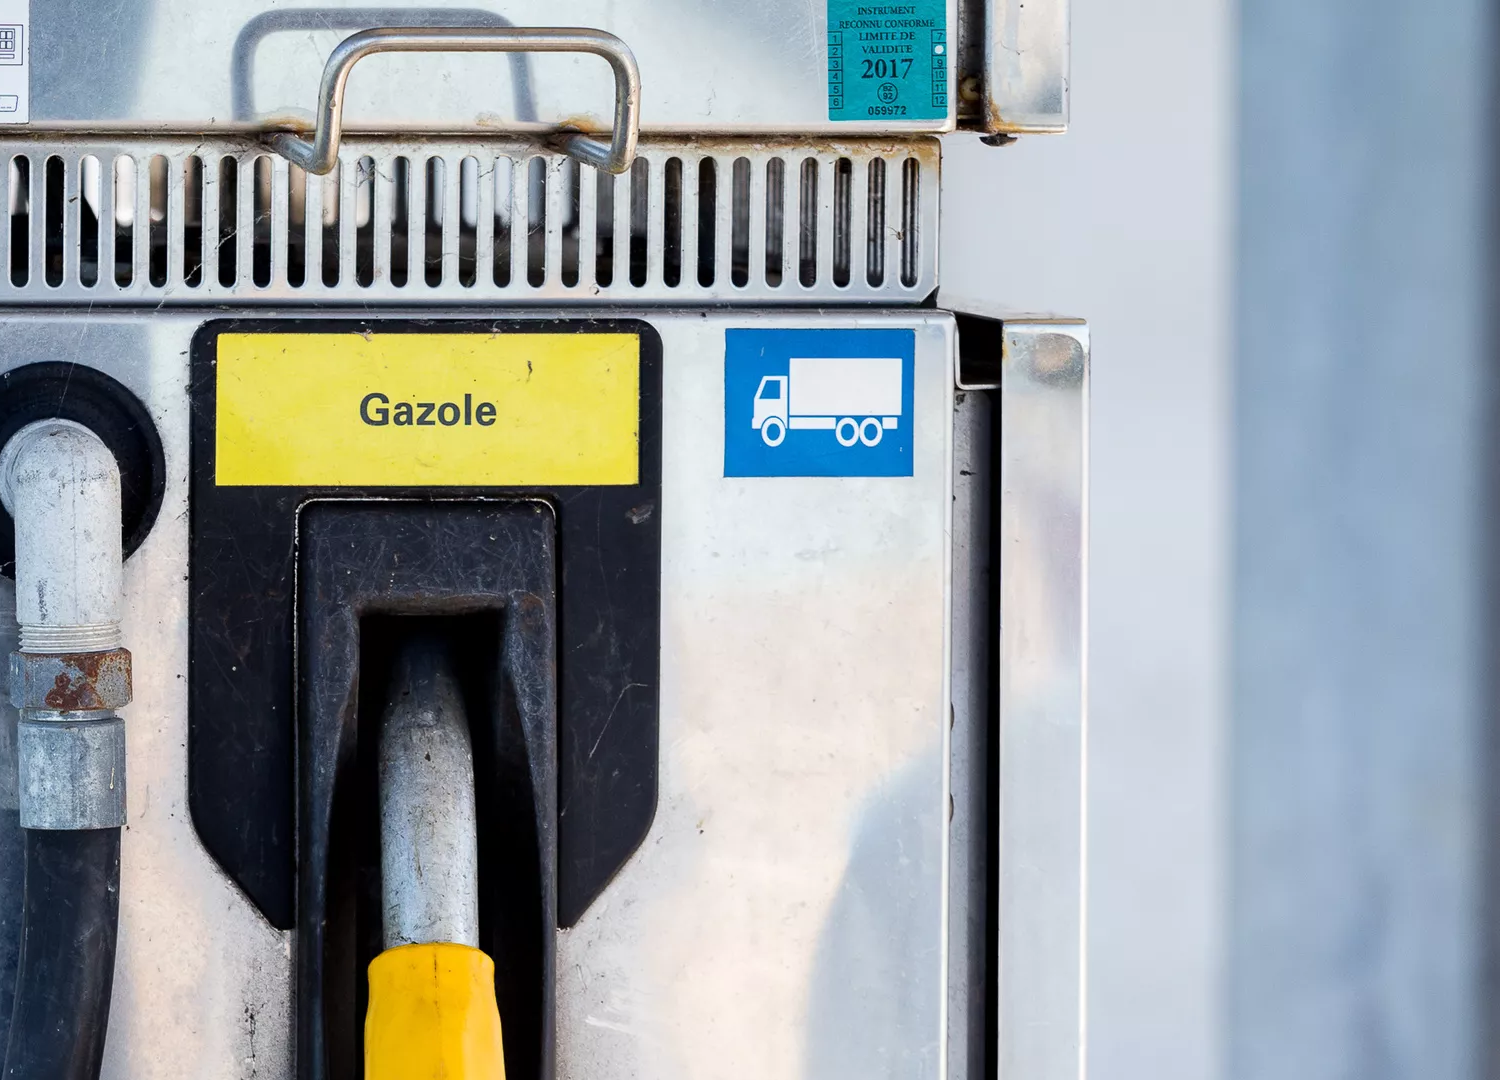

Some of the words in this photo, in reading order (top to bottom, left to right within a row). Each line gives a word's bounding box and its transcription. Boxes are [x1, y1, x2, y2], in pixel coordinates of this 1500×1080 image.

[857, 6, 916, 16] INSTRUMENT
[839, 19, 883, 29] RECONNU
[884, 18, 935, 28] CONFORME
[832, 35, 837, 43] 1
[859, 31, 898, 41] LIMITE
[899, 31, 916, 41] DE
[936, 32, 943, 41] 7
[832, 47, 839, 56] 2
[861, 45, 913, 54] VALIDITE
[832, 60, 839, 69] 3
[936, 59, 943, 68] 9
[861, 58, 914, 79] 2017
[832, 72, 839, 81] 4
[934, 70, 945, 80] 10
[833, 85, 840, 94] 5
[934, 83, 944, 92] 11
[882, 92, 893, 100] 92
[934, 95, 945, 105] 12
[833, 98, 840, 107] 6
[867, 105, 907, 116] 059972
[359, 392, 498, 427] Gazole
